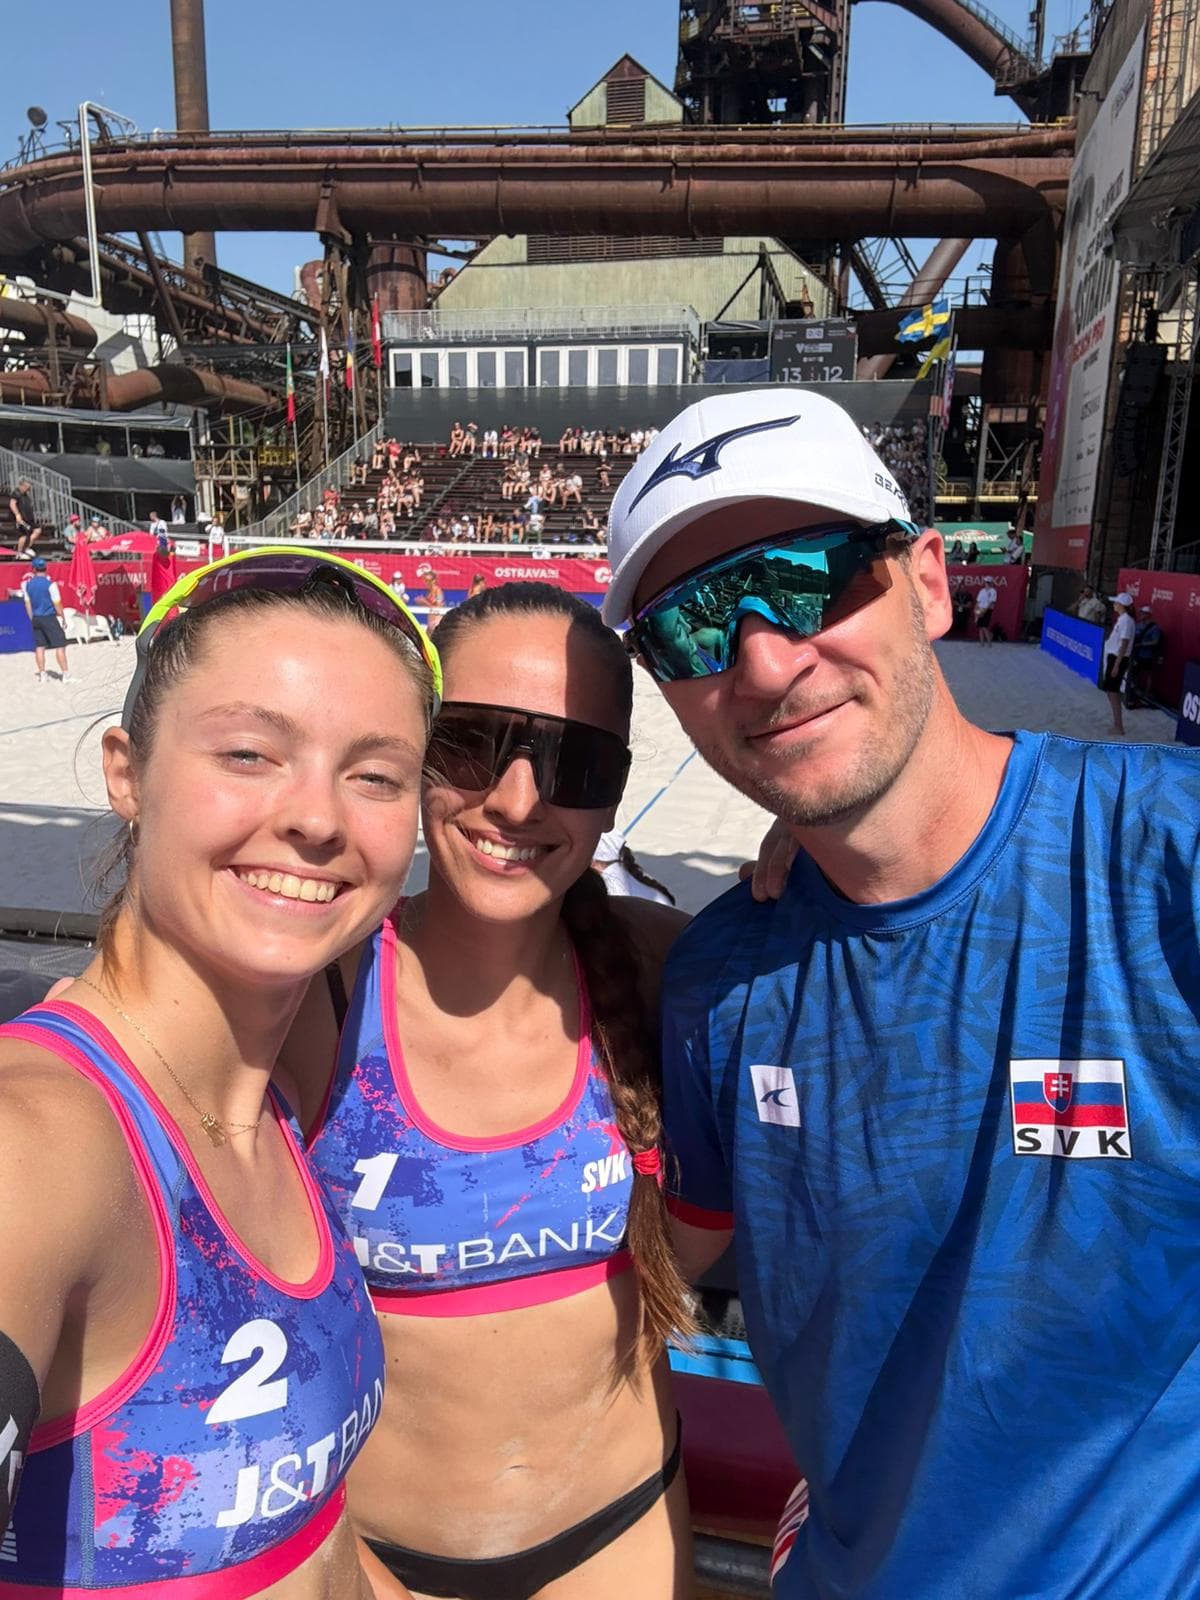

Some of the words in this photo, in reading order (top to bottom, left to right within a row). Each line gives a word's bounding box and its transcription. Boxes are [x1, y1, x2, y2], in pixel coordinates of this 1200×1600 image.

[782, 367, 802, 383] 13
[823, 366, 844, 382] 12
[964, 575, 1008, 587] BAKA
[1016, 1127, 1129, 1156] SVK
[351, 1152, 399, 1211] 1
[581, 1151, 627, 1193] SVK
[204, 1318, 288, 1425] 2
[215, 1432, 336, 1528] J&T
